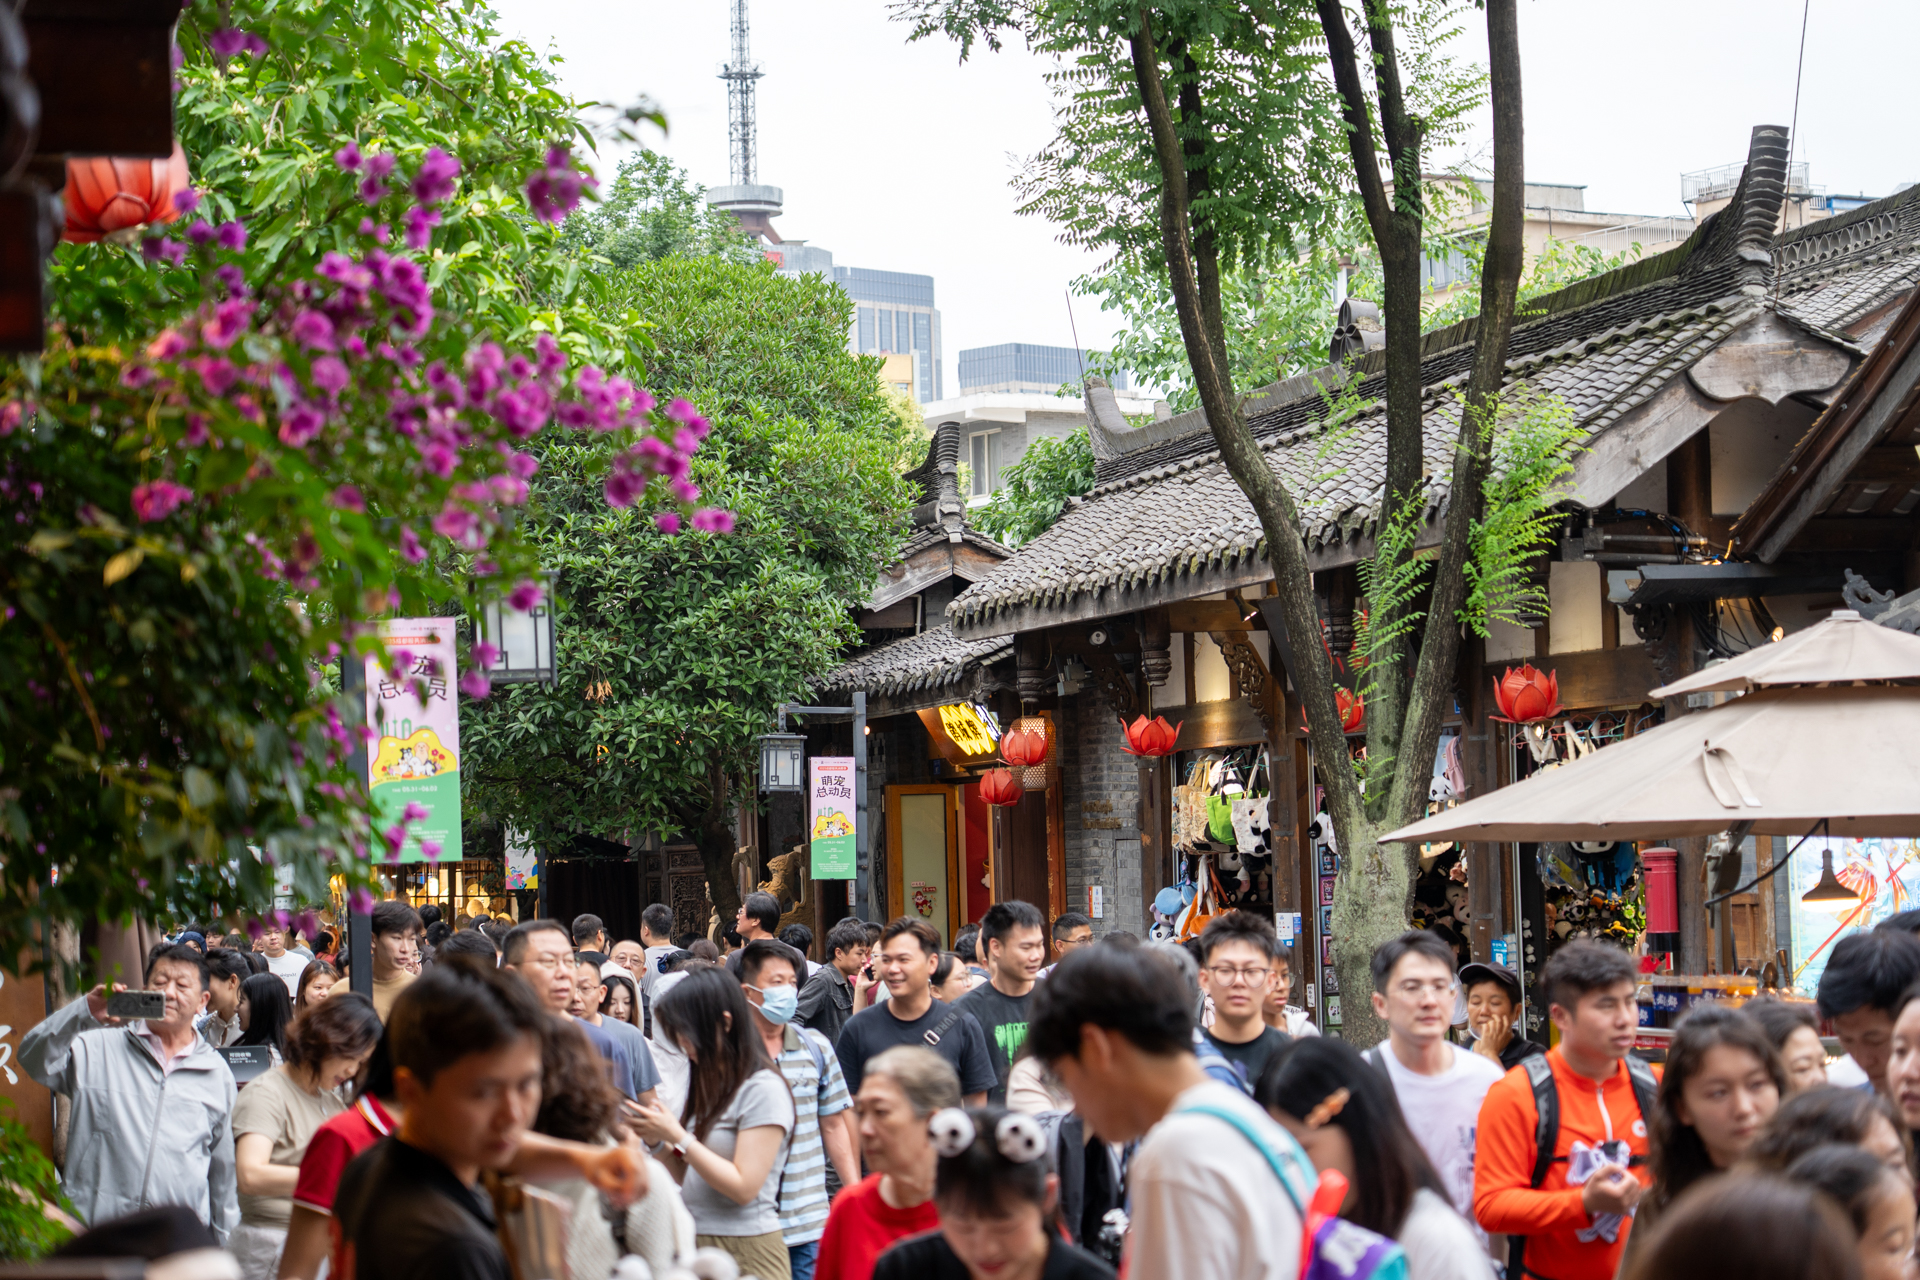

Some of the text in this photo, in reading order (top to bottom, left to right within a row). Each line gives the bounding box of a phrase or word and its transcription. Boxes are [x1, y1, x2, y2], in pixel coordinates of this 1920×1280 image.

[377, 677, 448, 701] 总员
[820, 775, 846, 787] 萌宠
[816, 786, 852, 799] 总动员
